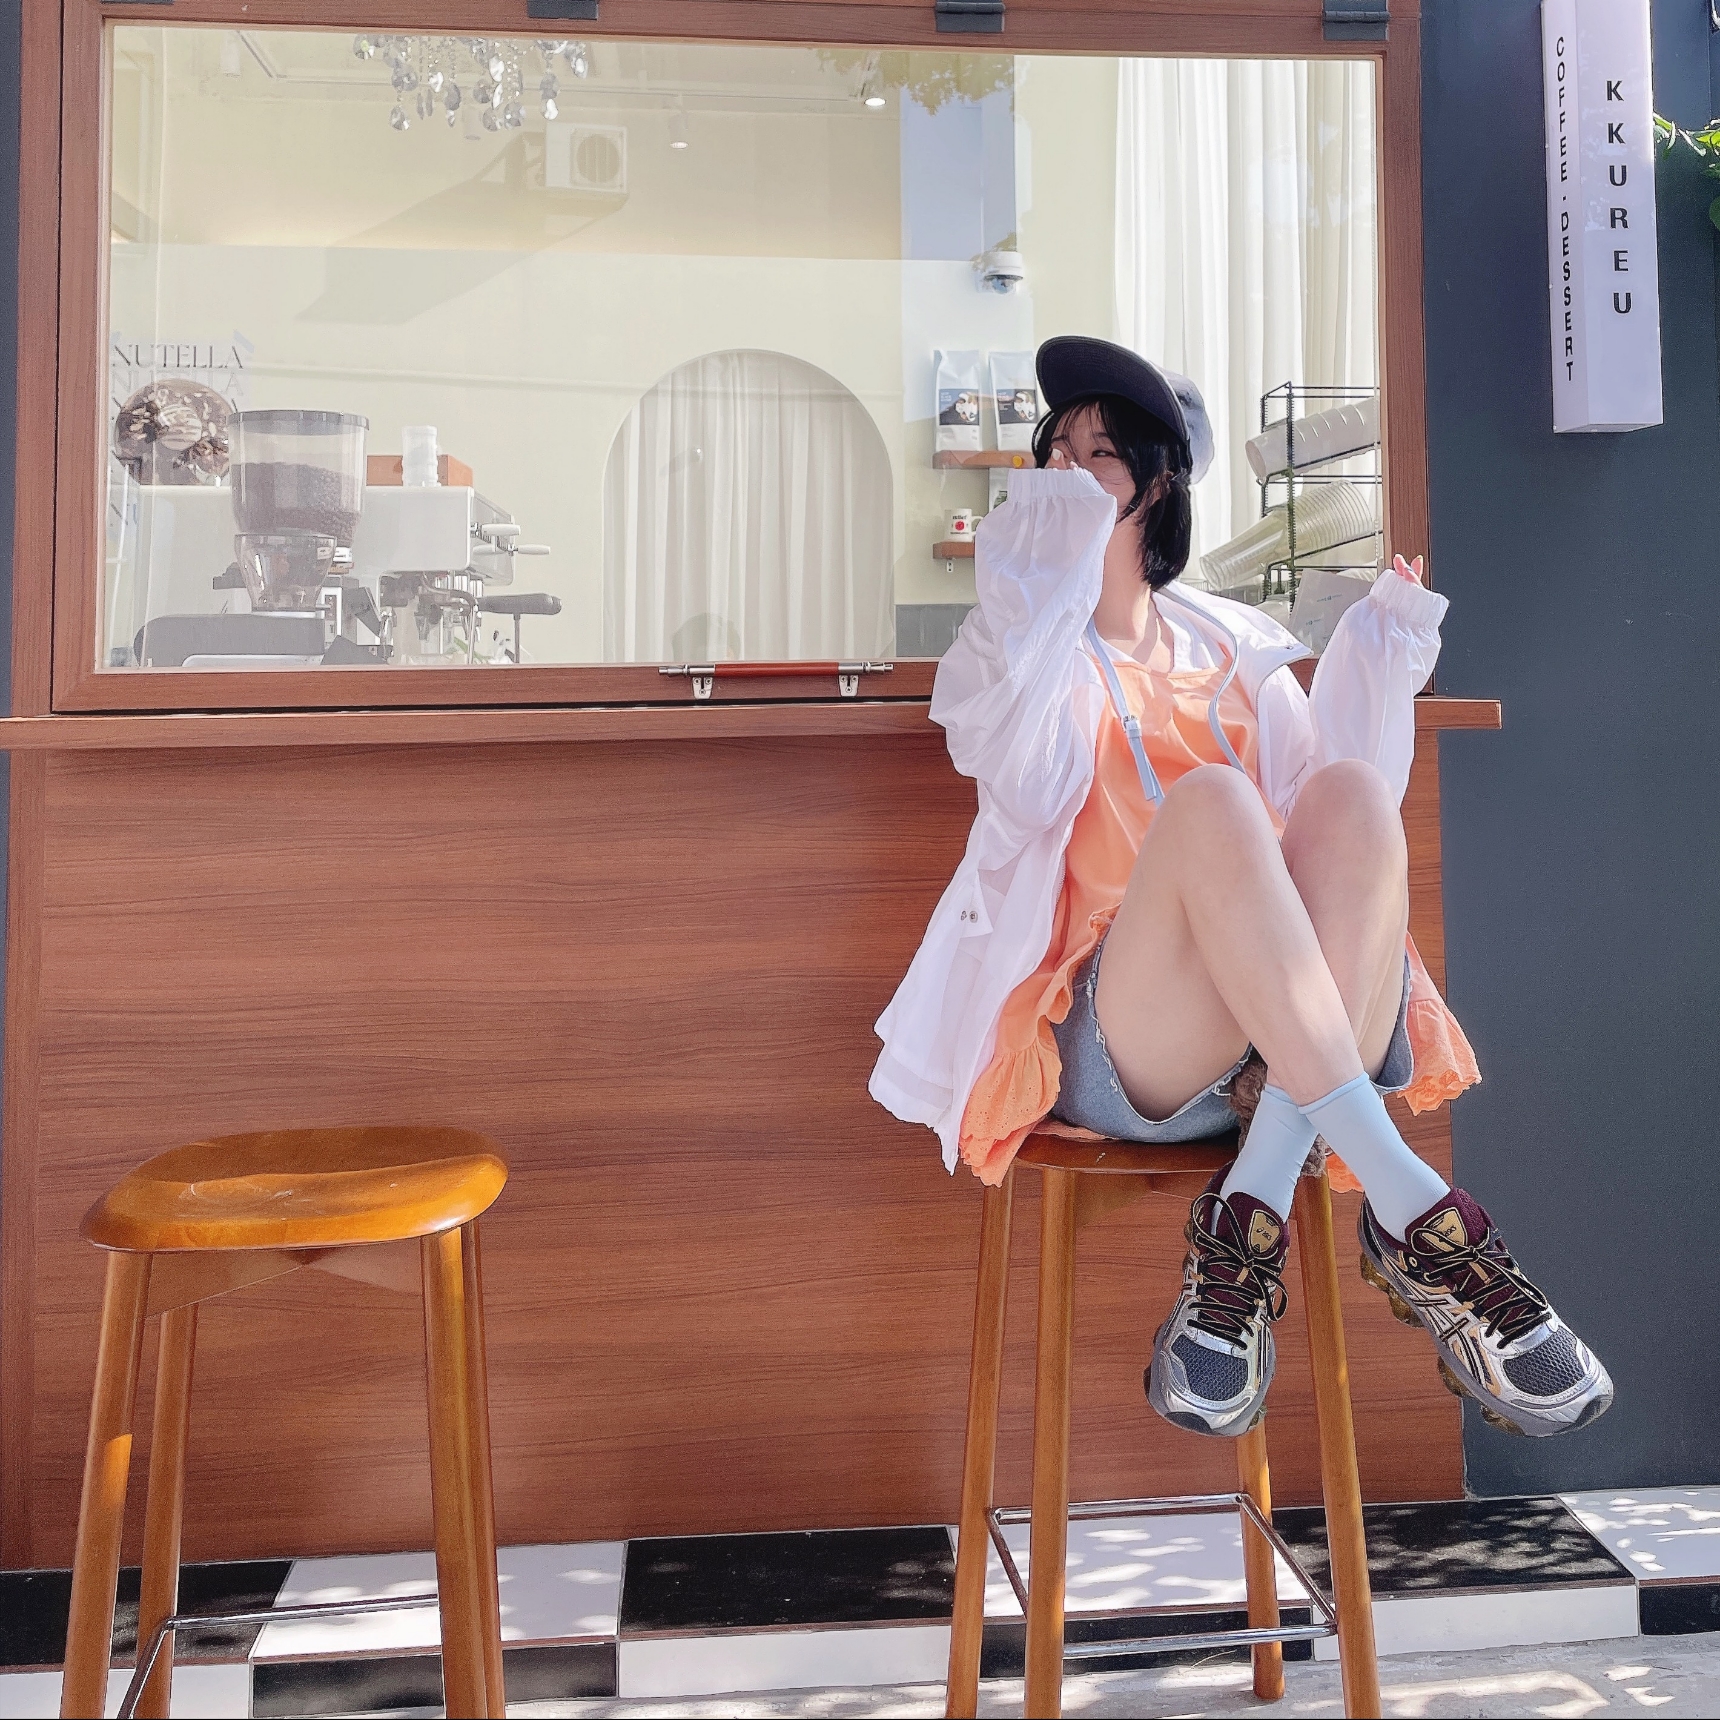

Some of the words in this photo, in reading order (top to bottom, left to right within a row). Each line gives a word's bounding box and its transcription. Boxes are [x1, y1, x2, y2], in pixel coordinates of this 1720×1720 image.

[1556, 36, 1567, 183] COFFEE
[1606, 80, 1632, 314] KKUREU
[112, 344, 243, 369] NUTELLA
[1561, 211, 1574, 382] DESSERT
